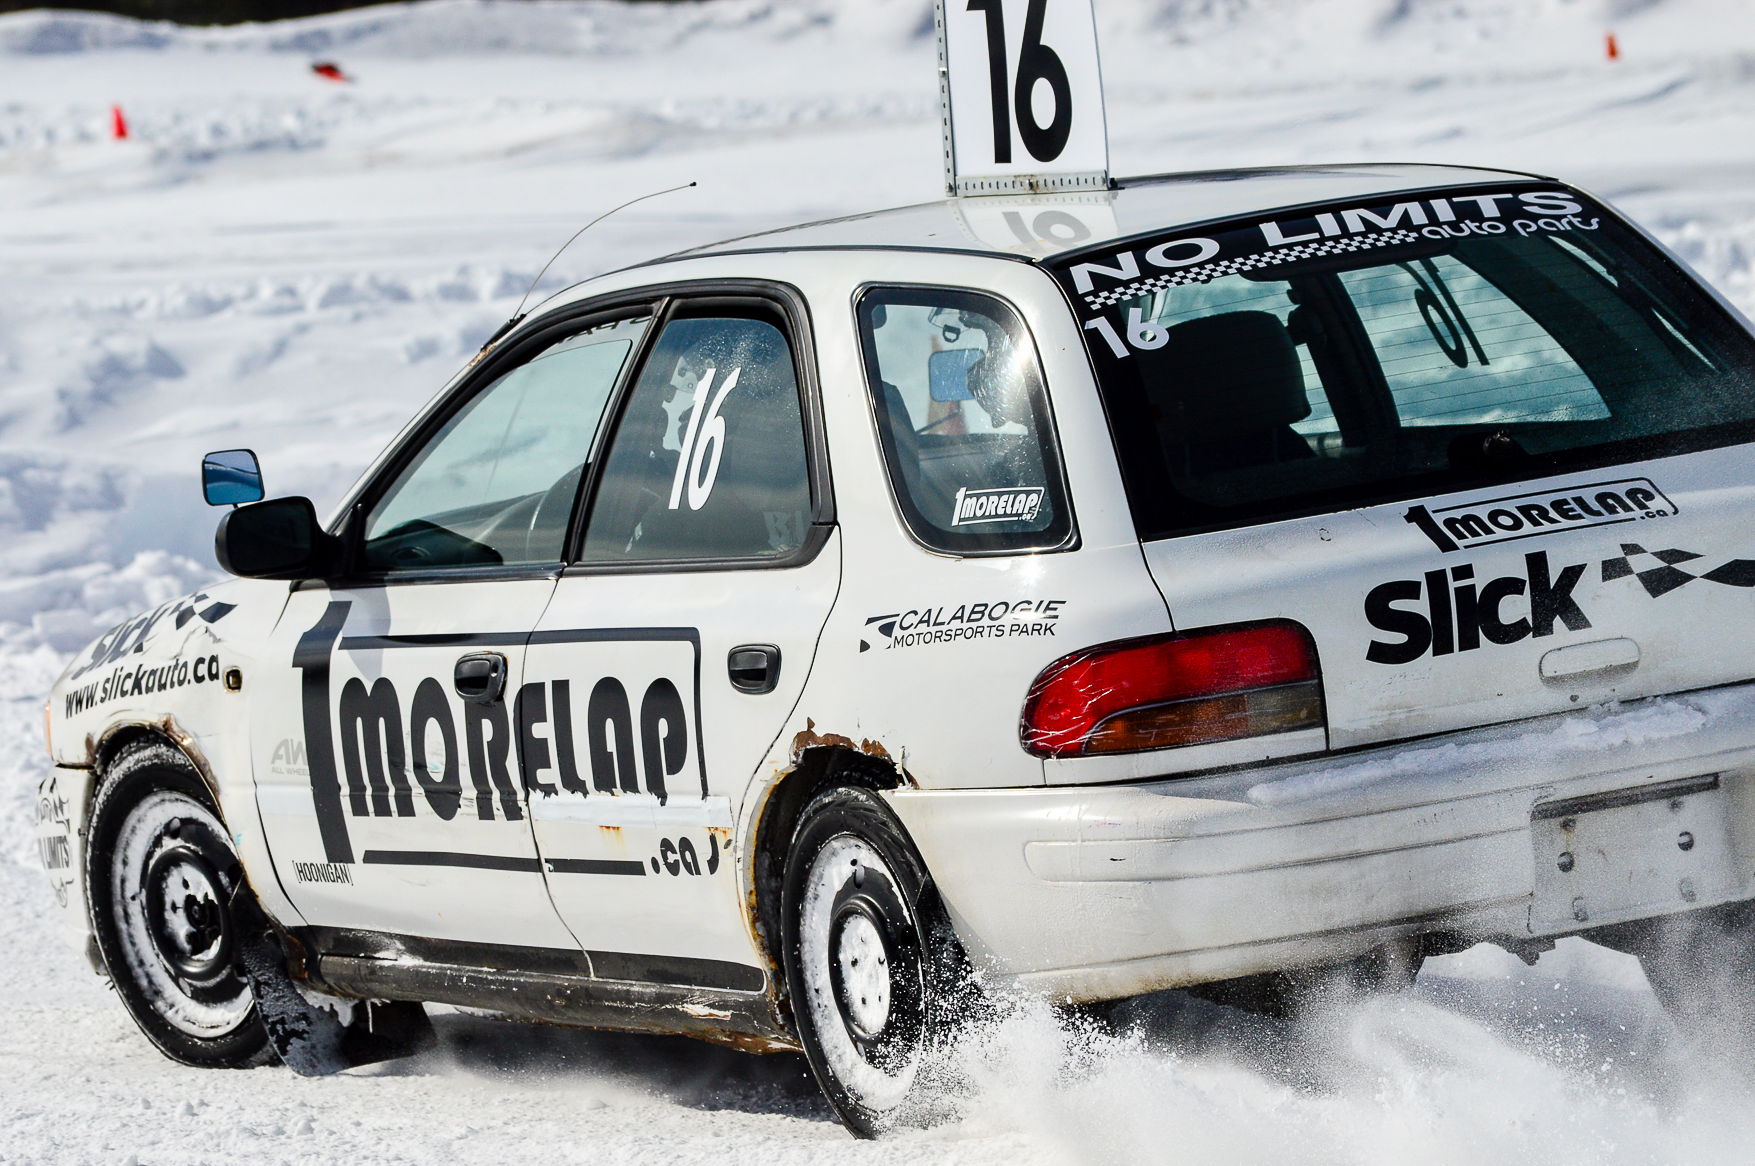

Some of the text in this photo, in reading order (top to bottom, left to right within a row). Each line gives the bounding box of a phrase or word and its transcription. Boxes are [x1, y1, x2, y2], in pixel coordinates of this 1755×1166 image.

[966, 0, 1072, 164] 16
[1069, 192, 1583, 295] NO LIMITS
[1421, 215, 1600, 239] auto parts
[1084, 307, 1170, 359] 16
[669, 367, 742, 511] 16
[893, 622, 1057, 649] MOTORSPORTS PARK
[898, 600, 1067, 631] CALABOGIE
[1364, 550, 1593, 665] Slick
[65, 654, 220, 719] www.slickauto.ca
[271, 738, 308, 766] AW
